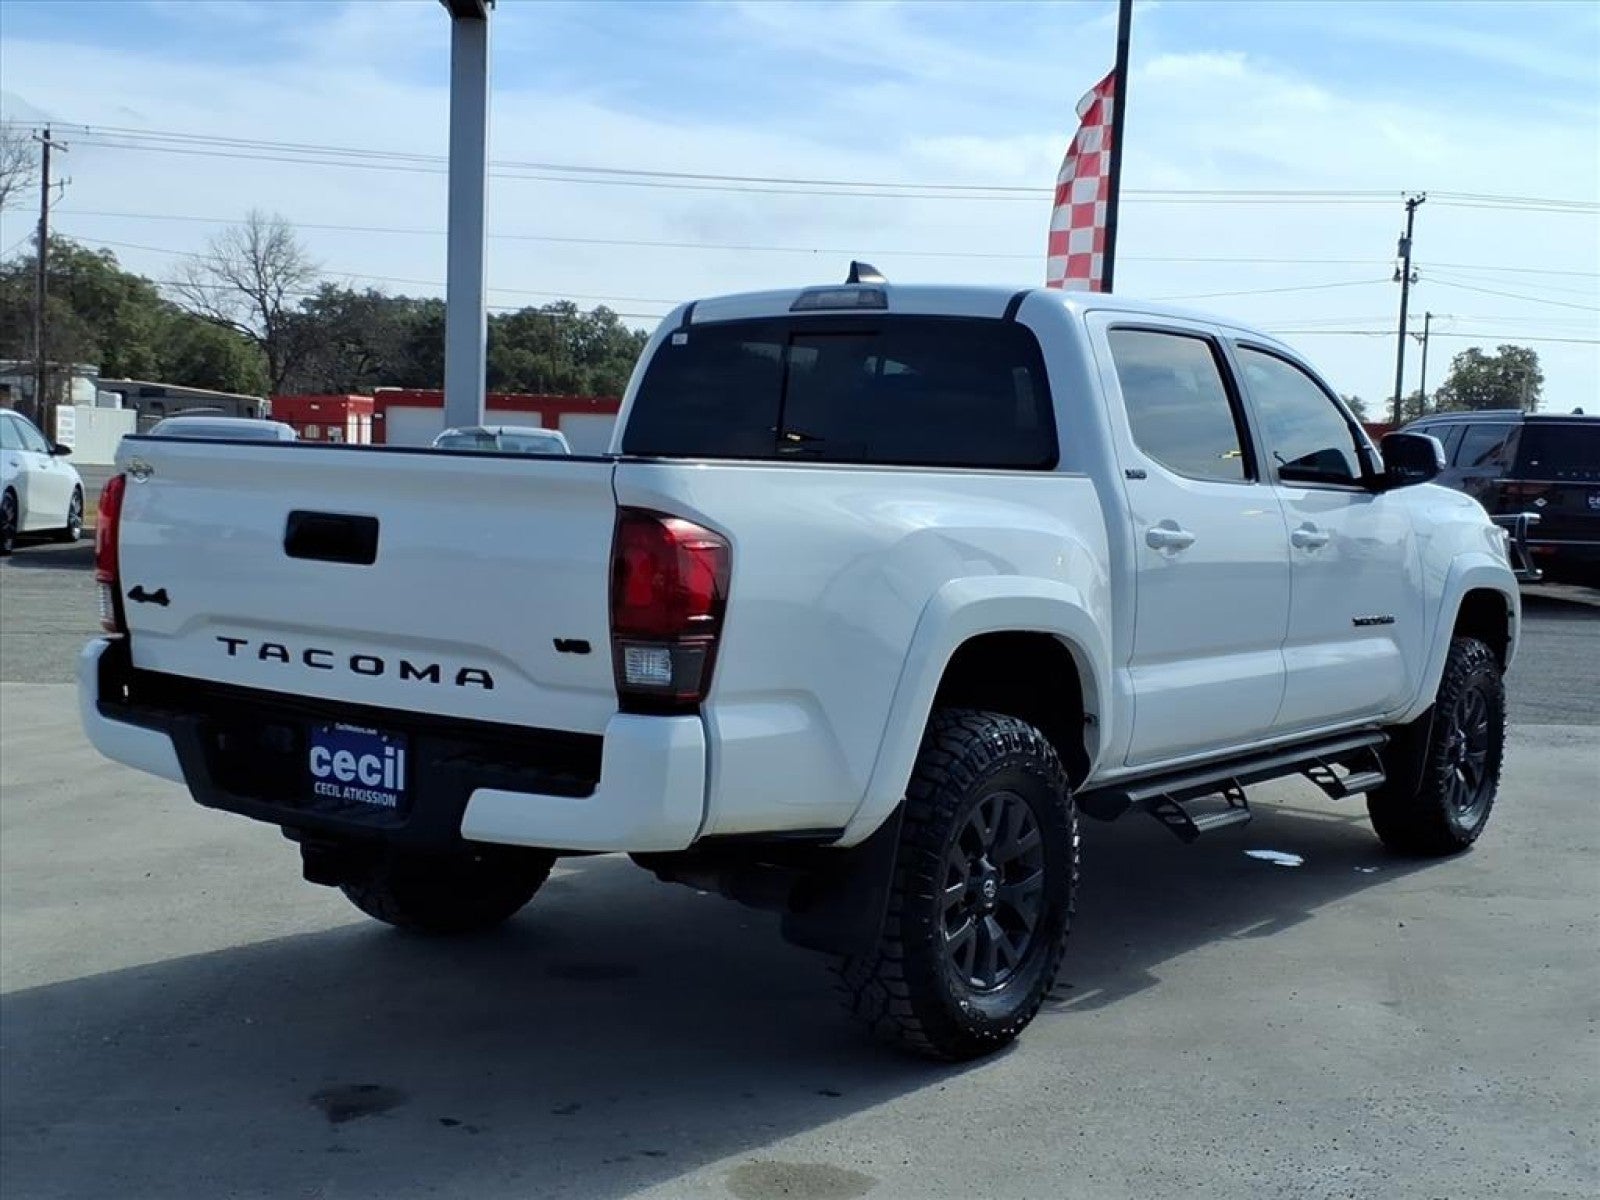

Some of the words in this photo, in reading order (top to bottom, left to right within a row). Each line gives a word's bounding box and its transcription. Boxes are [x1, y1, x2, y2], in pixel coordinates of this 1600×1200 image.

[216, 636, 495, 690] TACOMA
[310, 746, 405, 790] cecil
[314, 782, 341, 798] CECIL
